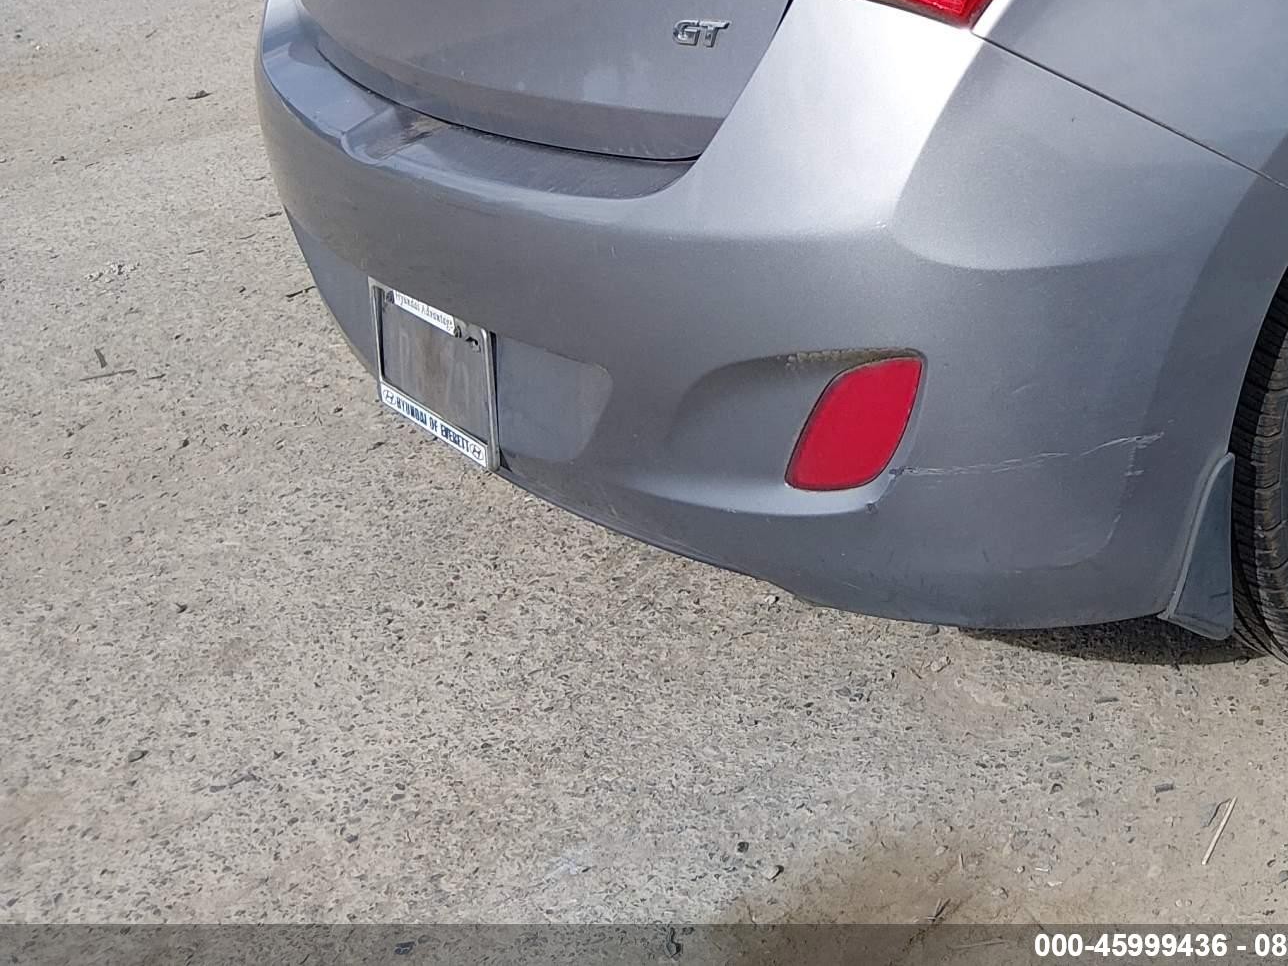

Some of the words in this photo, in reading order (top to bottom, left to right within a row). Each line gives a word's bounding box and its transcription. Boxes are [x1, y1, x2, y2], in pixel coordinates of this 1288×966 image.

[673, 19, 732, 48] GT
[396, 396, 428, 426] HYUNDAI
[429, 417, 438, 433] OF
[440, 423, 470, 453] EVERETT
